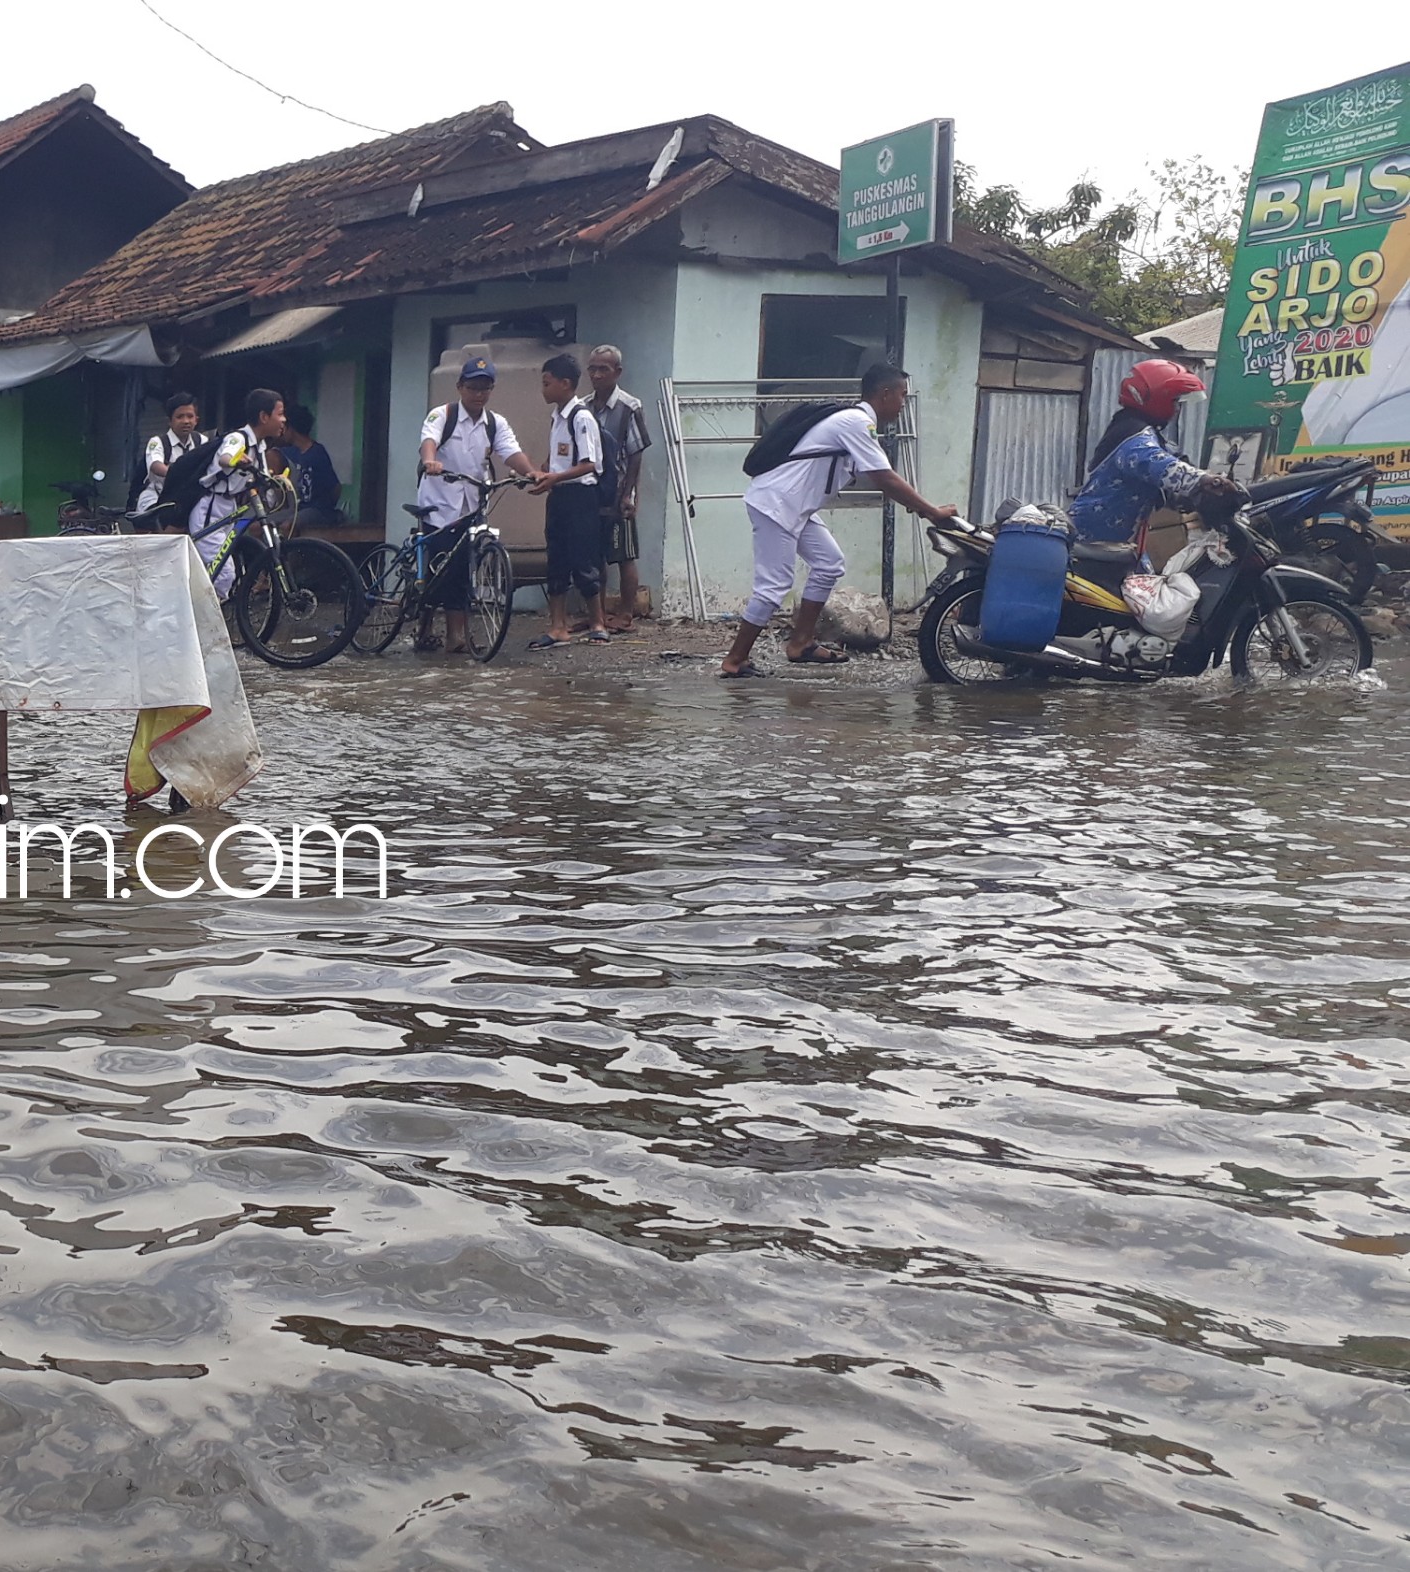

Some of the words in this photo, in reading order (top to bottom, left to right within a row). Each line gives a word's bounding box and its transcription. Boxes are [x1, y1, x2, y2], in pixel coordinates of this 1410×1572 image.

[853, 174, 917, 207] PUSKESMAS
[1247, 152, 1410, 238] BHS
[846, 192, 925, 229] TANGGULANGIN
[1277, 239, 1334, 270] Untuk
[1246, 250, 1385, 304] SIDO
[1237, 287, 1380, 337] ARJO
[1293, 324, 1375, 356] 2020
[1294, 350, 1367, 383] BAIK
[207, 530, 236, 576] IATOR
